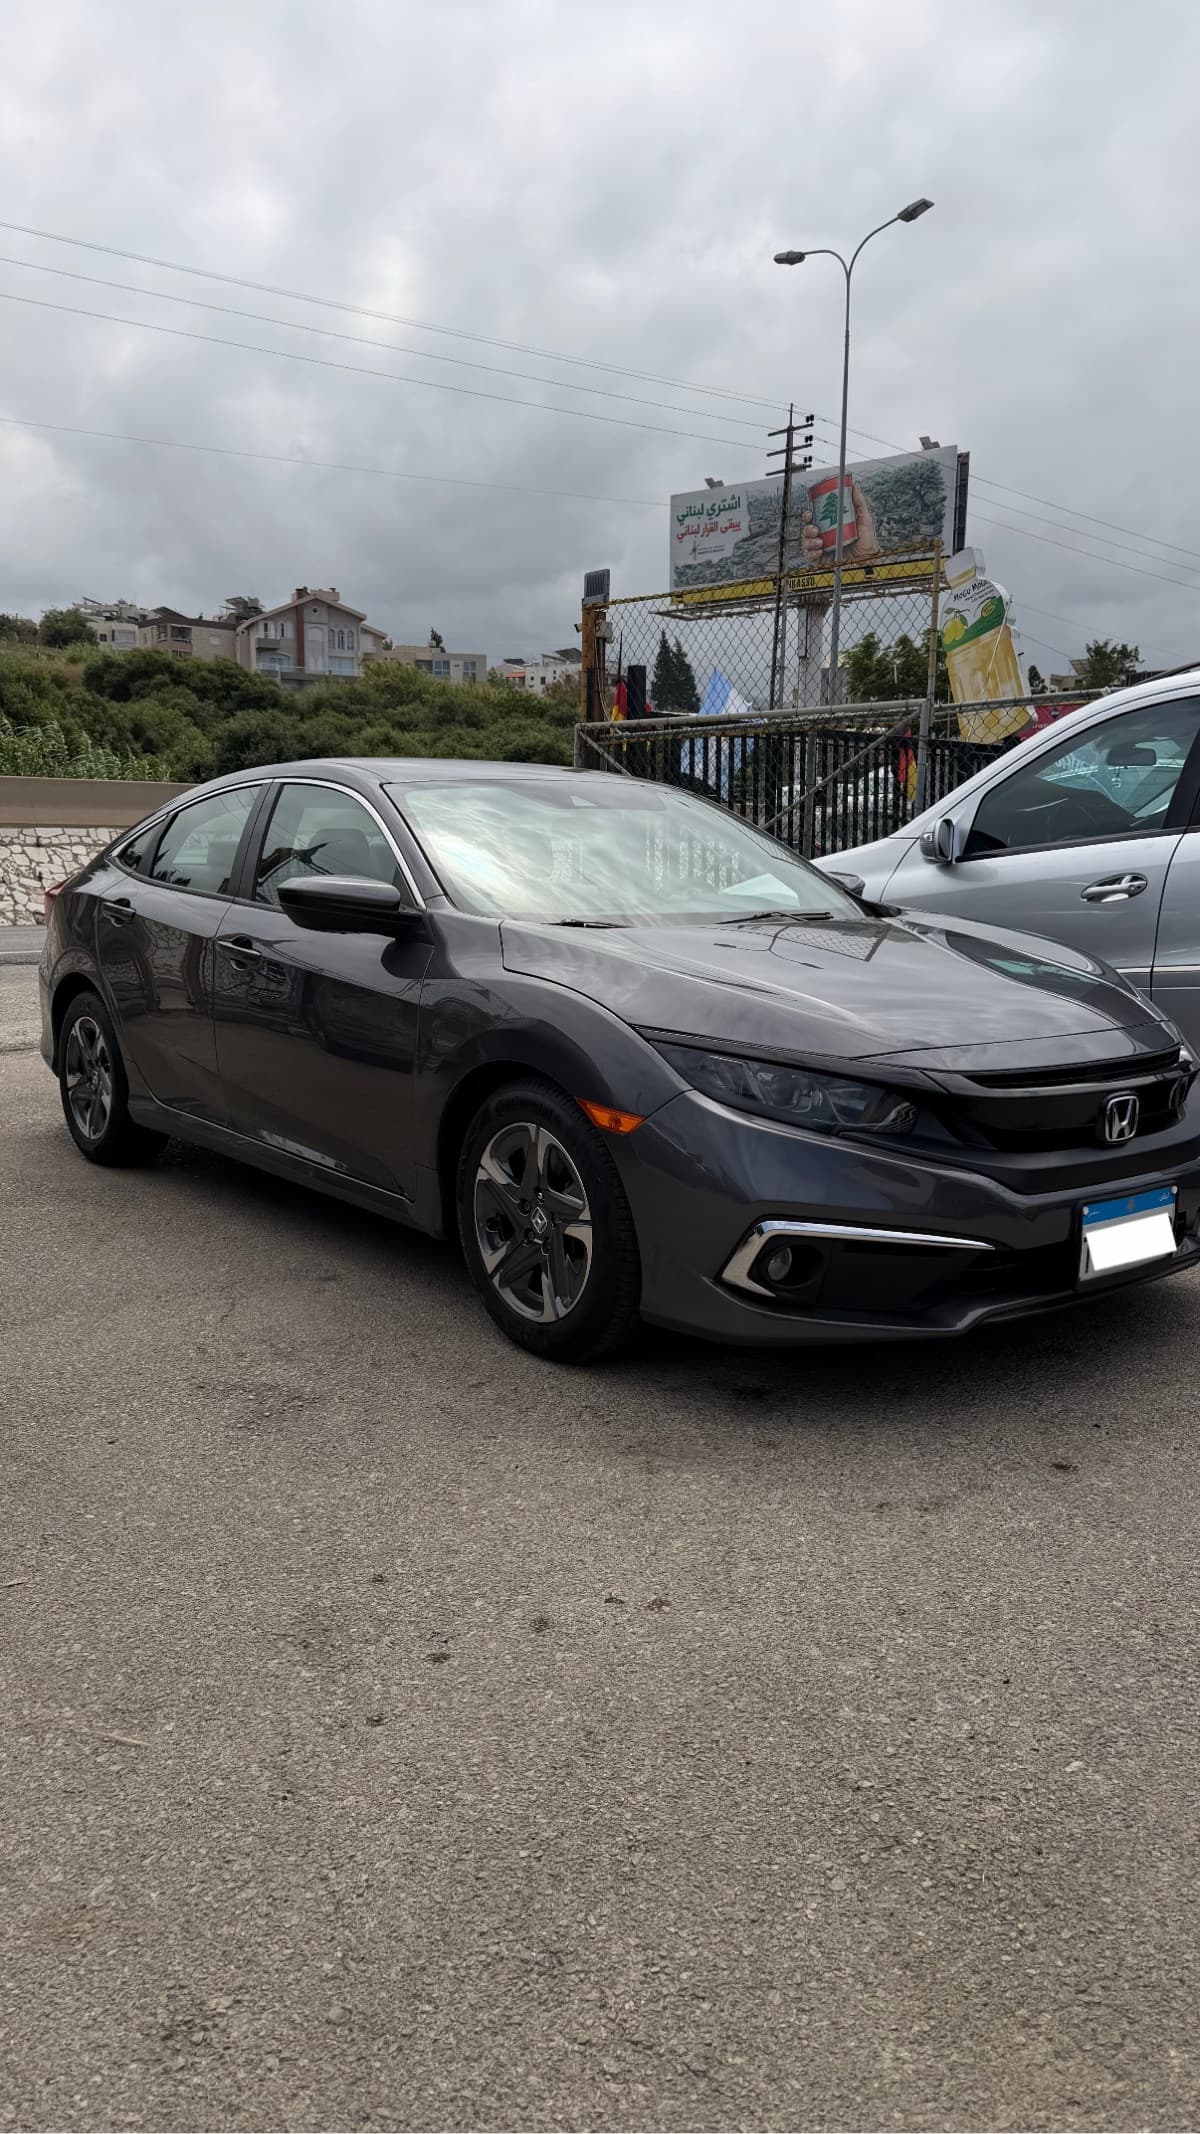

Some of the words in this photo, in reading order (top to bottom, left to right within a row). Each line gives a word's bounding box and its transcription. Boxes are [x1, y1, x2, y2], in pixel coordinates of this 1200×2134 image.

[677, 503, 704, 526] لبناني
[707, 494, 740, 520] اشتري
[677, 523, 700, 543] لبناني
[787, 577, 815, 589] IKASSO
